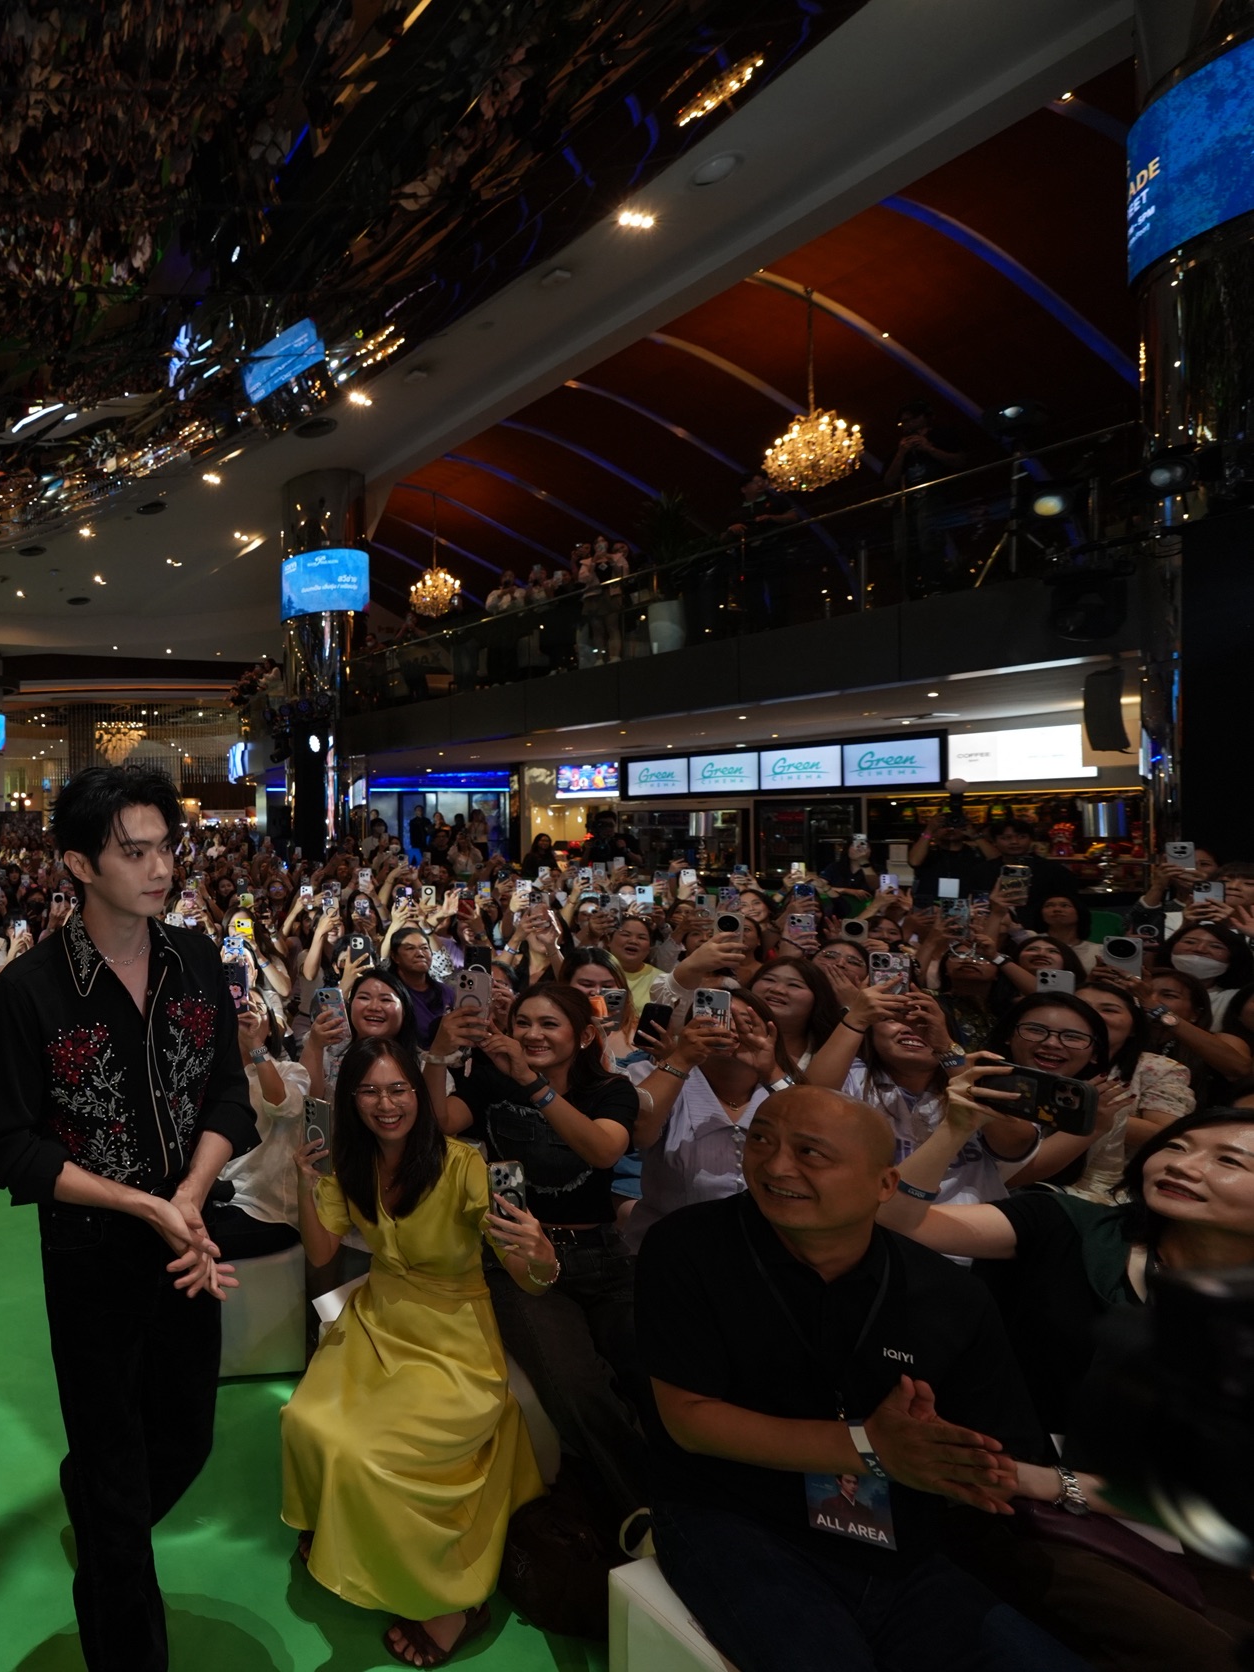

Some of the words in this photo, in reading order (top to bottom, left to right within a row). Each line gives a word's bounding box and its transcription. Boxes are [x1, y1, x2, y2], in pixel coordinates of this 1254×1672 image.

[772, 757, 822, 775] Green
[857, 751, 917, 771] Green
[638, 767, 675, 783] Green
[701, 762, 744, 779] Green
[883, 1347, 914, 1365] iQIYI
[816, 1513, 845, 1532] ALL
[848, 1521, 889, 1544] AREA
